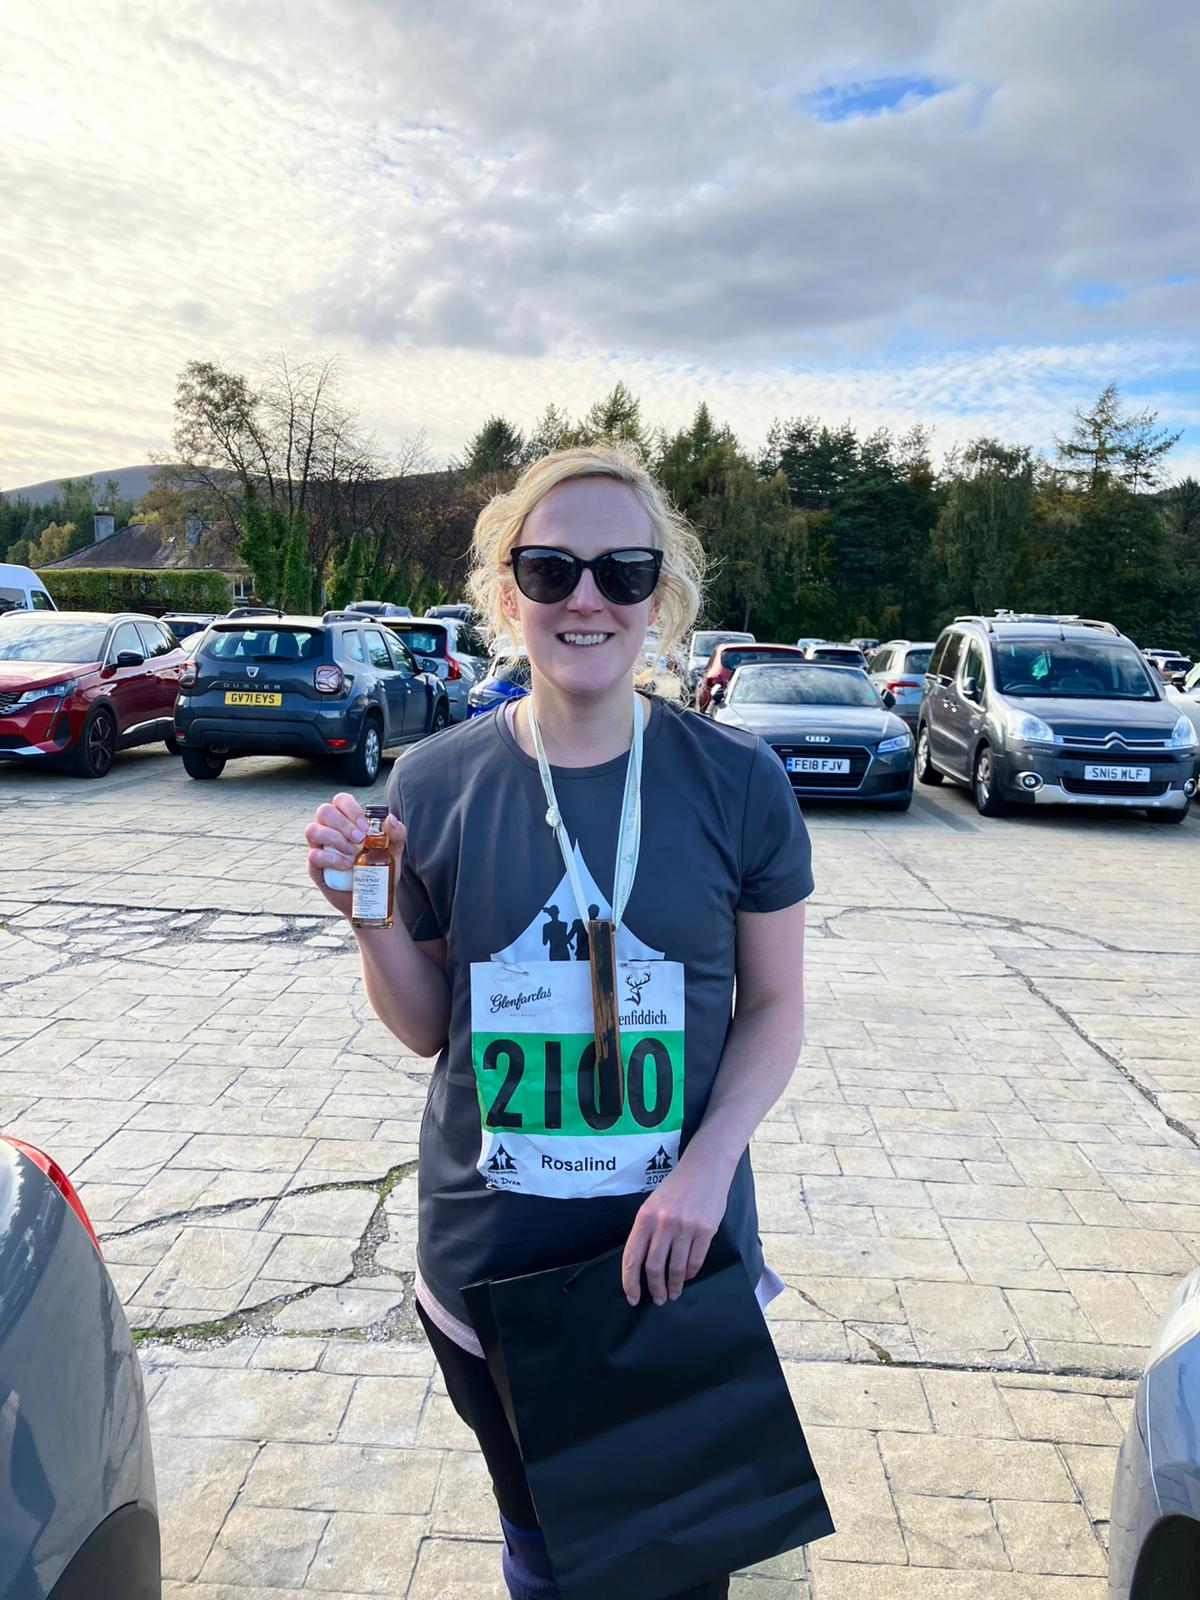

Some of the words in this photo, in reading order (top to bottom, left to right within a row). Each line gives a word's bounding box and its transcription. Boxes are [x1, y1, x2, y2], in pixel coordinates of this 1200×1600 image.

[223, 682, 281, 690] DUSTER
[231, 693, 253, 703] GV71
[255, 693, 275, 704] EYS
[821, 760, 843, 771] FJV
[490, 986, 552, 1014] Glenfarclas
[618, 1009, 667, 1026] enfiddich
[483, 1038, 673, 1130] 2100
[541, 1154, 616, 1172] Rosalind
[646, 1173, 669, 1185] 202
